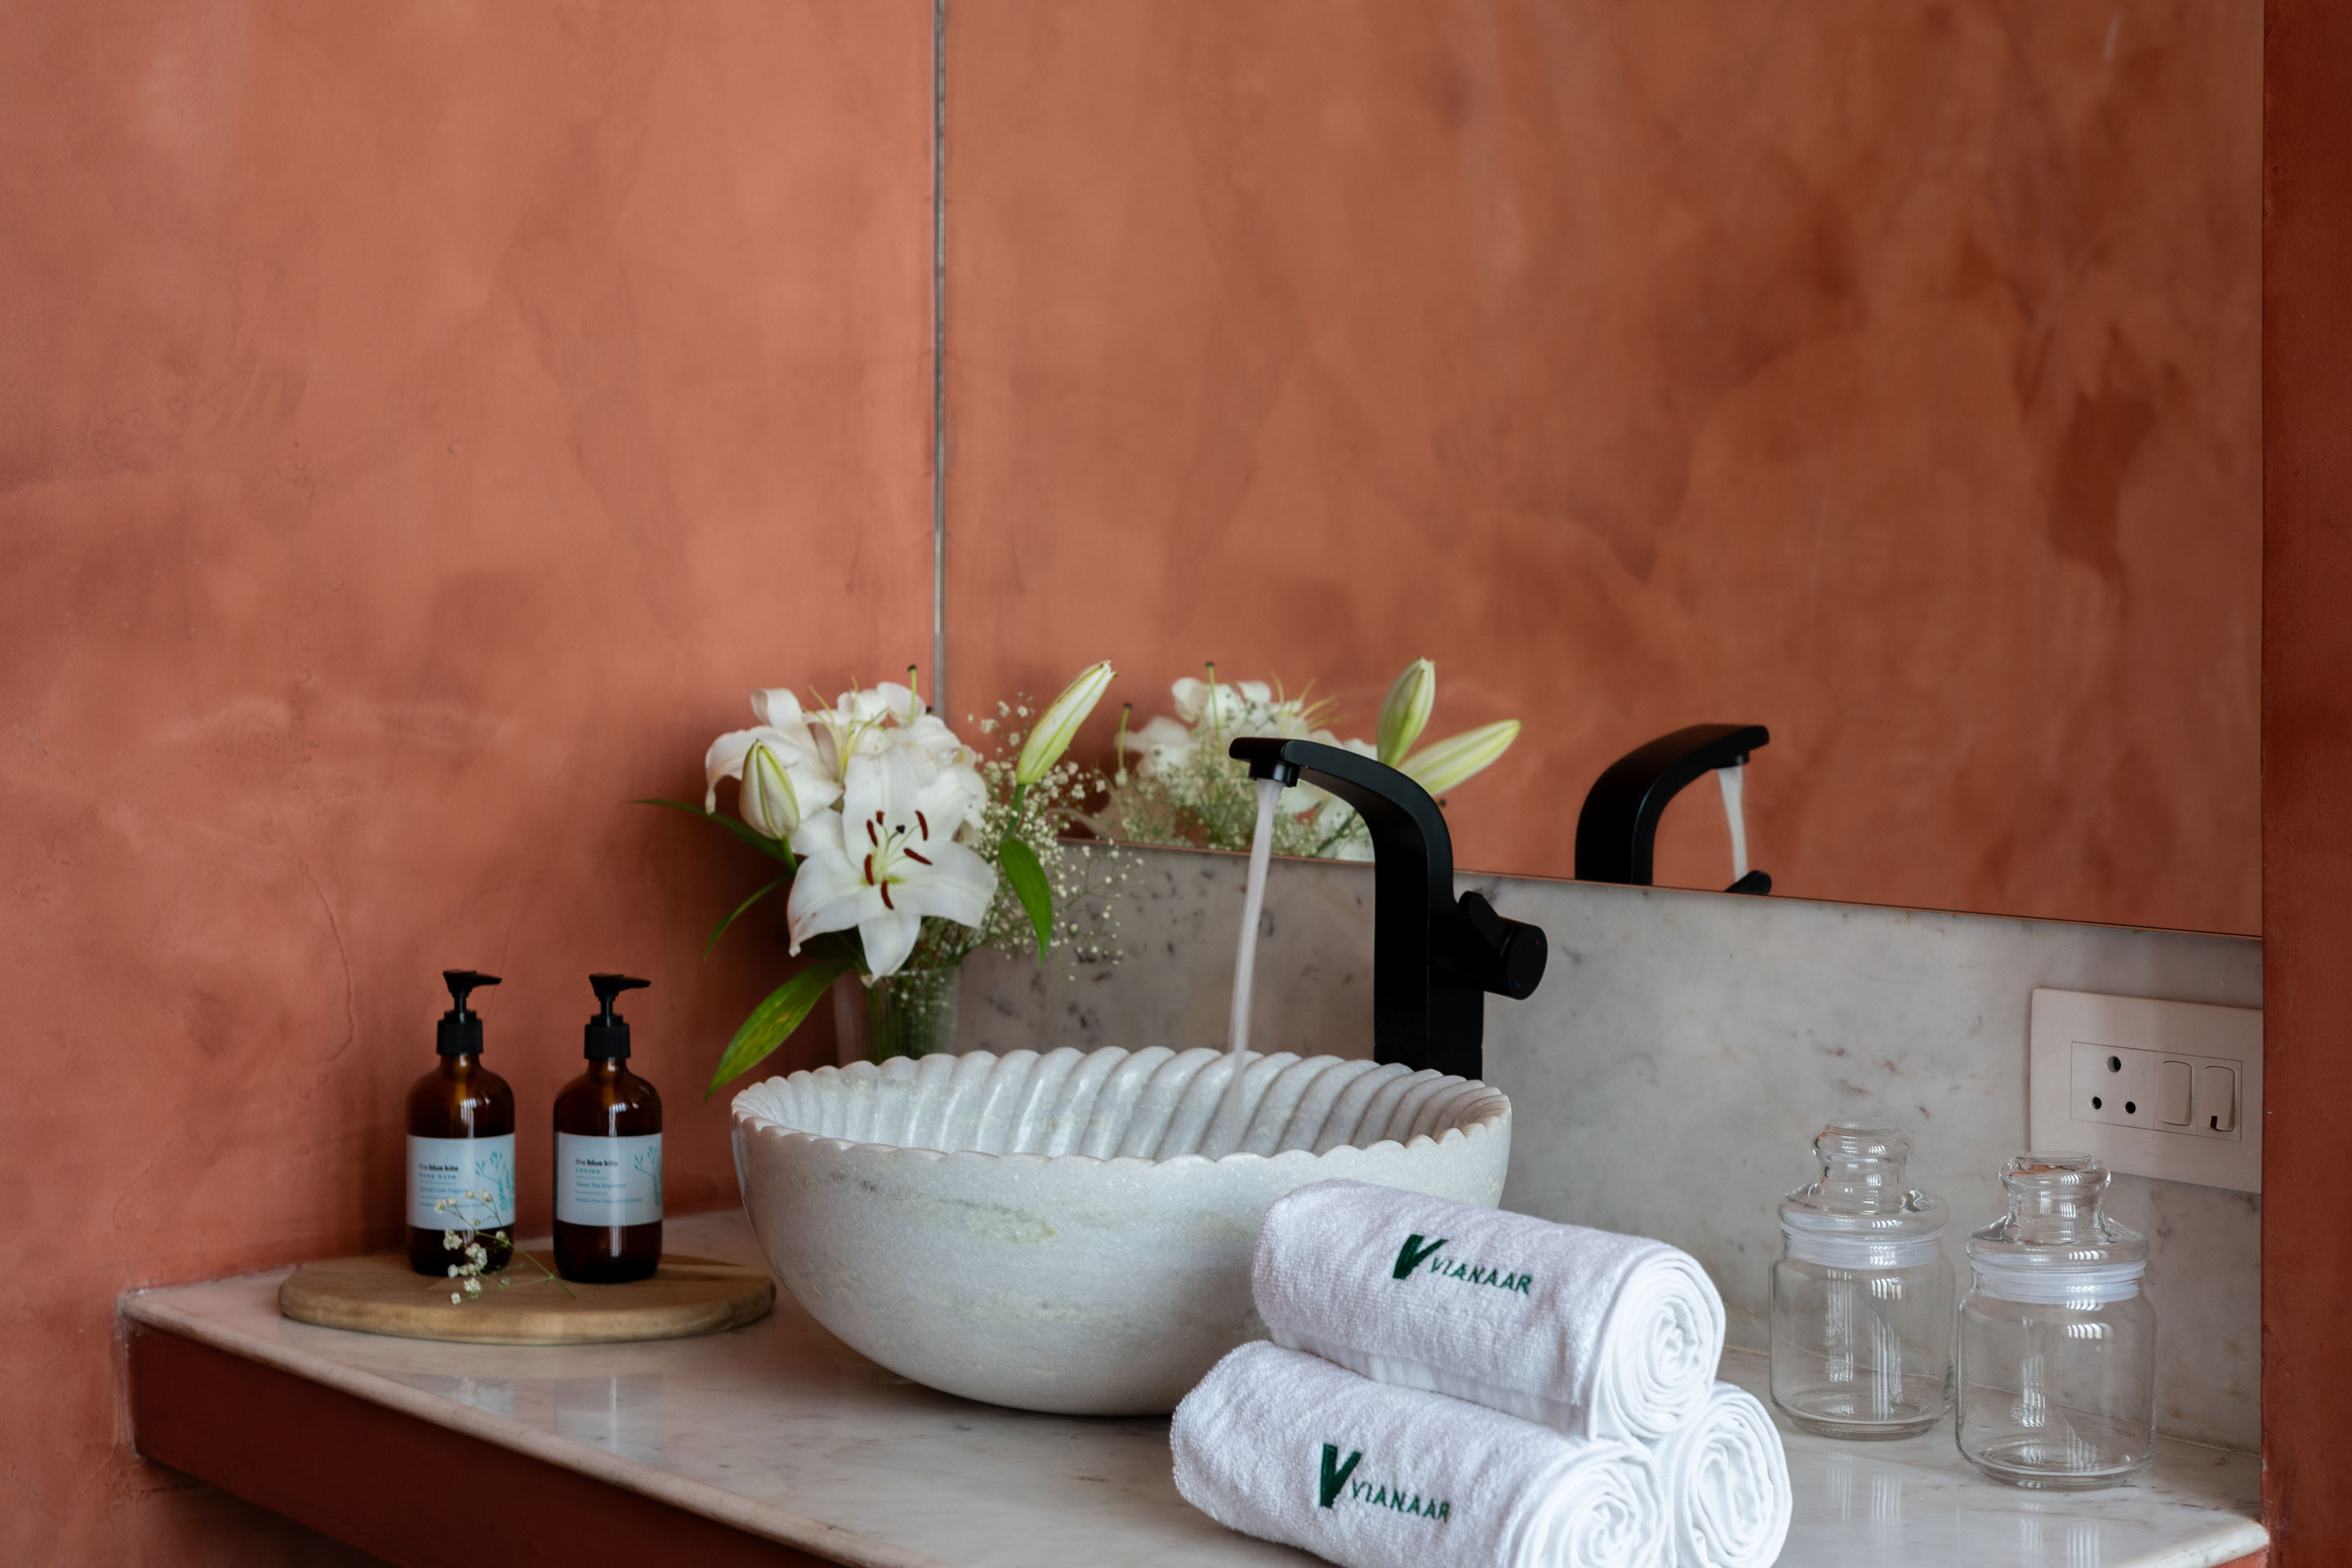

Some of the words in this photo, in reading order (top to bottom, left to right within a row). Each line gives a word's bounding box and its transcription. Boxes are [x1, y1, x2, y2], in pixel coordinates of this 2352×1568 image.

[429, 1163, 443, 1171] blue
[586, 1158, 603, 1166] blue
[604, 1158, 619, 1166] kite
[1429, 1258, 1533, 1295] VIANAAR
[1352, 1478, 1451, 1524] VIANAAR
